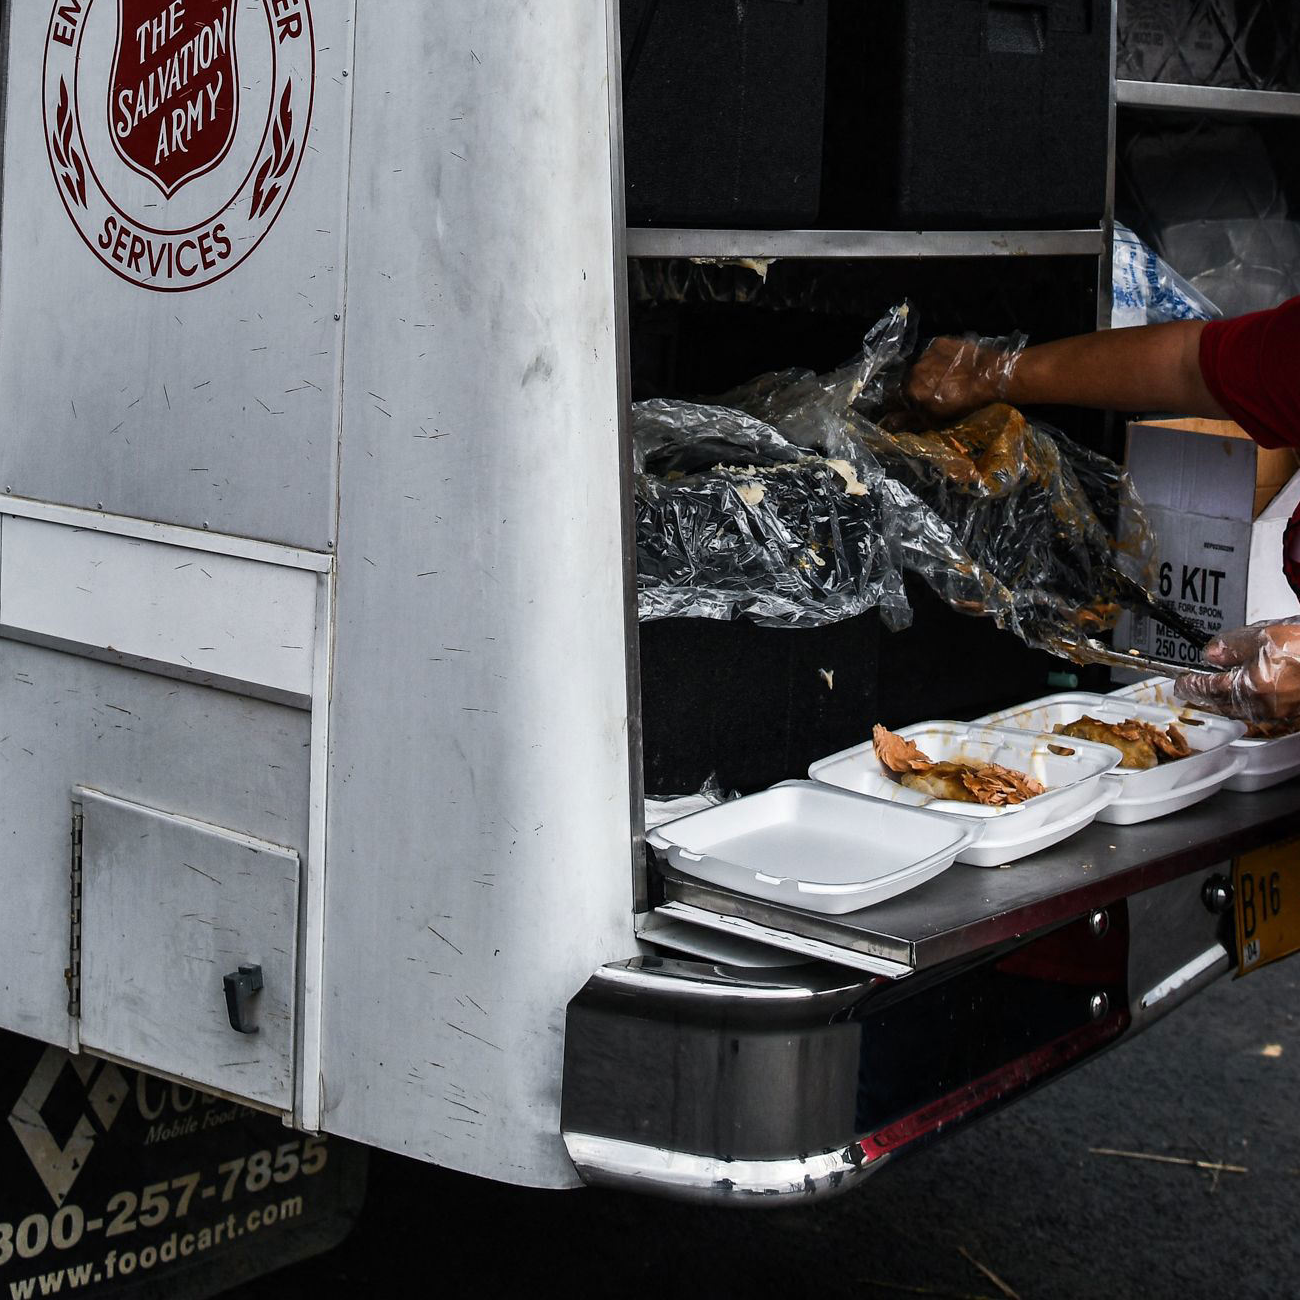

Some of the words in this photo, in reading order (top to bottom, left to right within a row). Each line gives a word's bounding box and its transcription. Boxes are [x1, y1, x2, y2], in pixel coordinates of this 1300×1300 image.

[116, 7, 228, 138] SALVATION
[154, 70, 222, 166] ARMY
[98, 215, 232, 279] SERVICES
[1178, 602, 1197, 615] FORK,
[1199, 606, 1224, 620] SPOON,
[1181, 565, 1226, 605] KIT
[1156, 638, 1175, 658] 250
[143, 1115, 198, 1146] Mobile
[201, 1103, 237, 1131] Food
[9, 1194, 303, 1300] www.foodcart.com
